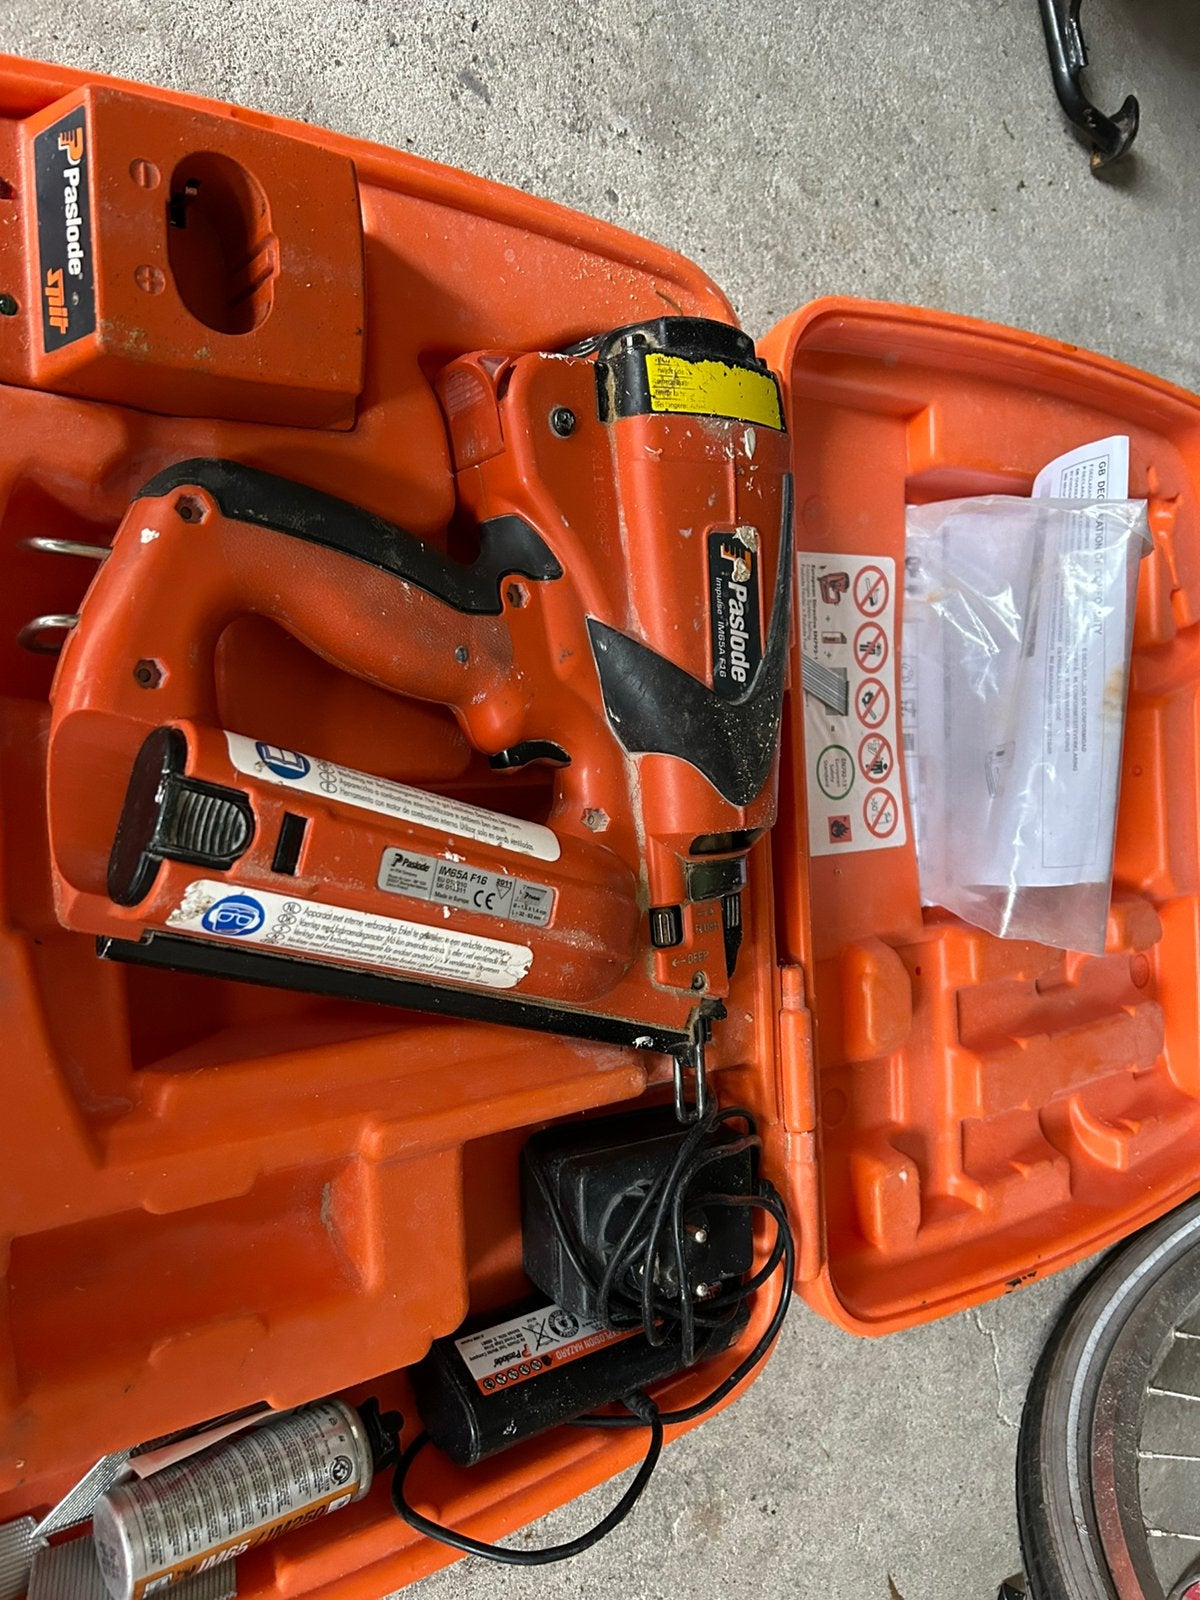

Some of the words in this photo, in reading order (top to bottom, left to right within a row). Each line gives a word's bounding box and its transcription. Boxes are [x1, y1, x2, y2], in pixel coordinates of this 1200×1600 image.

[63, 166, 82, 276] Paslode
[1097, 461, 1106, 476] GB
[1094, 480, 1106, 549] DECATION
[715, 577, 724, 615] Impulse
[717, 621, 727, 659] IM65A
[728, 582, 750, 683] Paslode
[402, 858, 430, 873] Paslode
[438, 866, 468, 881] IM65A
[470, 873, 488, 886] F16
[496, 878, 512, 888] 2011
[584, 1328, 622, 1349] XPLOSION
[493, 1350, 521, 1368] Paslode
[556, 1340, 586, 1360] HAZARD
[197, 1538, 251, 1573] IM65
